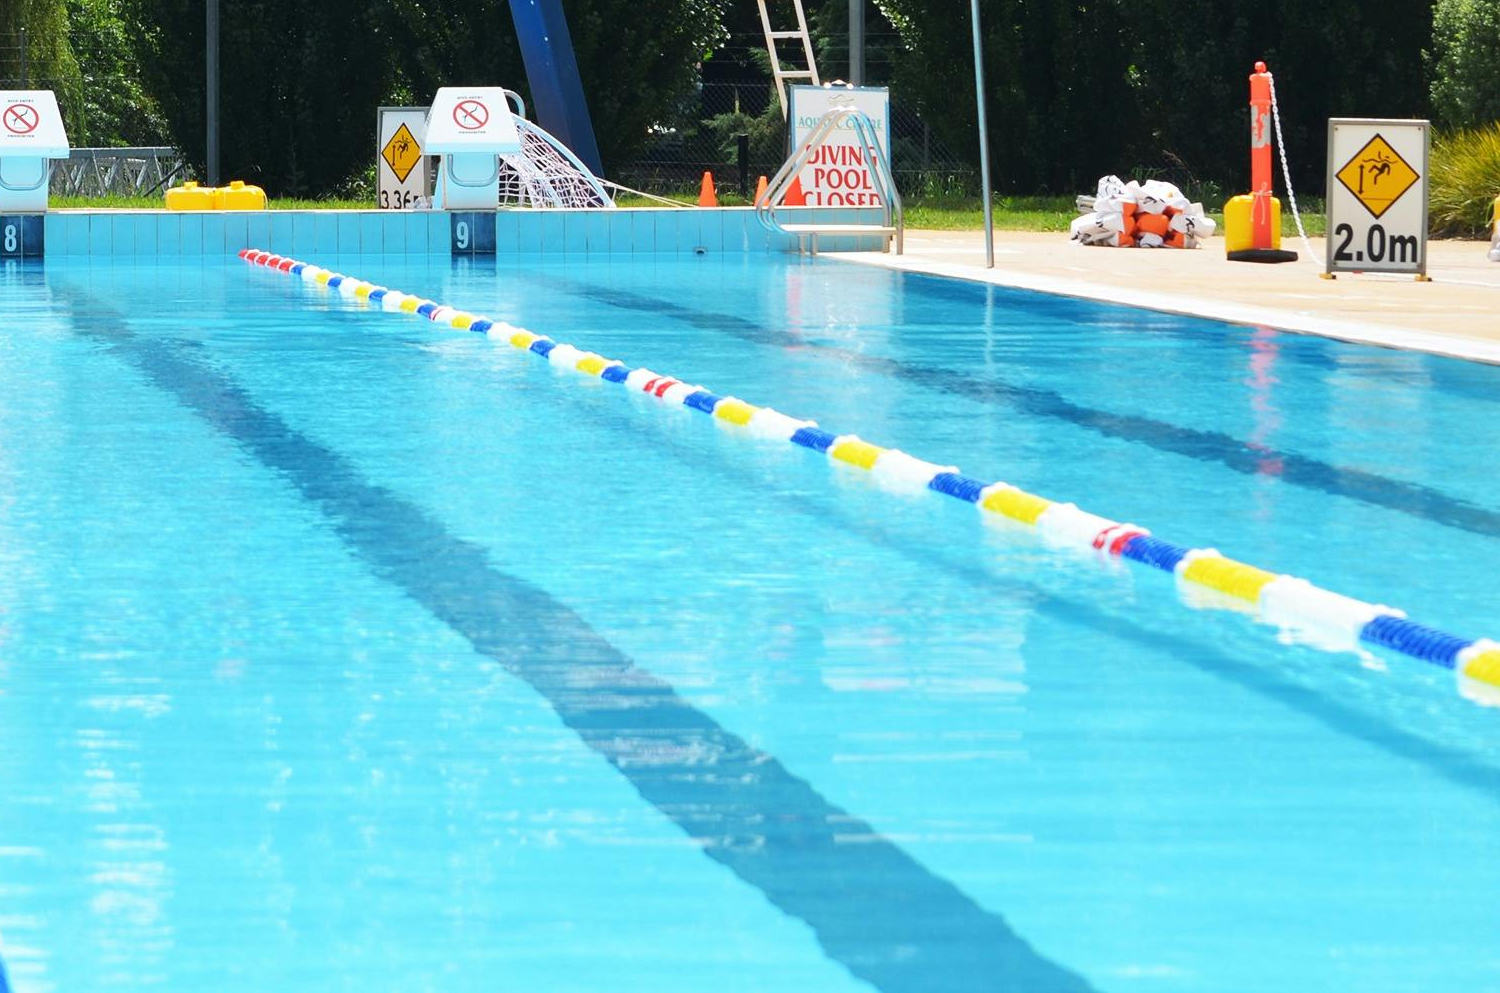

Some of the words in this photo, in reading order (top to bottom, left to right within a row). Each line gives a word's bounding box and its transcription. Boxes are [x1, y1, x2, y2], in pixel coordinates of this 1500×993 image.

[814, 168, 872, 190] POOL
[803, 191, 881, 206] CLOSED
[4, 224, 17, 252] 8
[456, 221, 469, 249] 9
[1333, 223, 1418, 263] 2.0m
